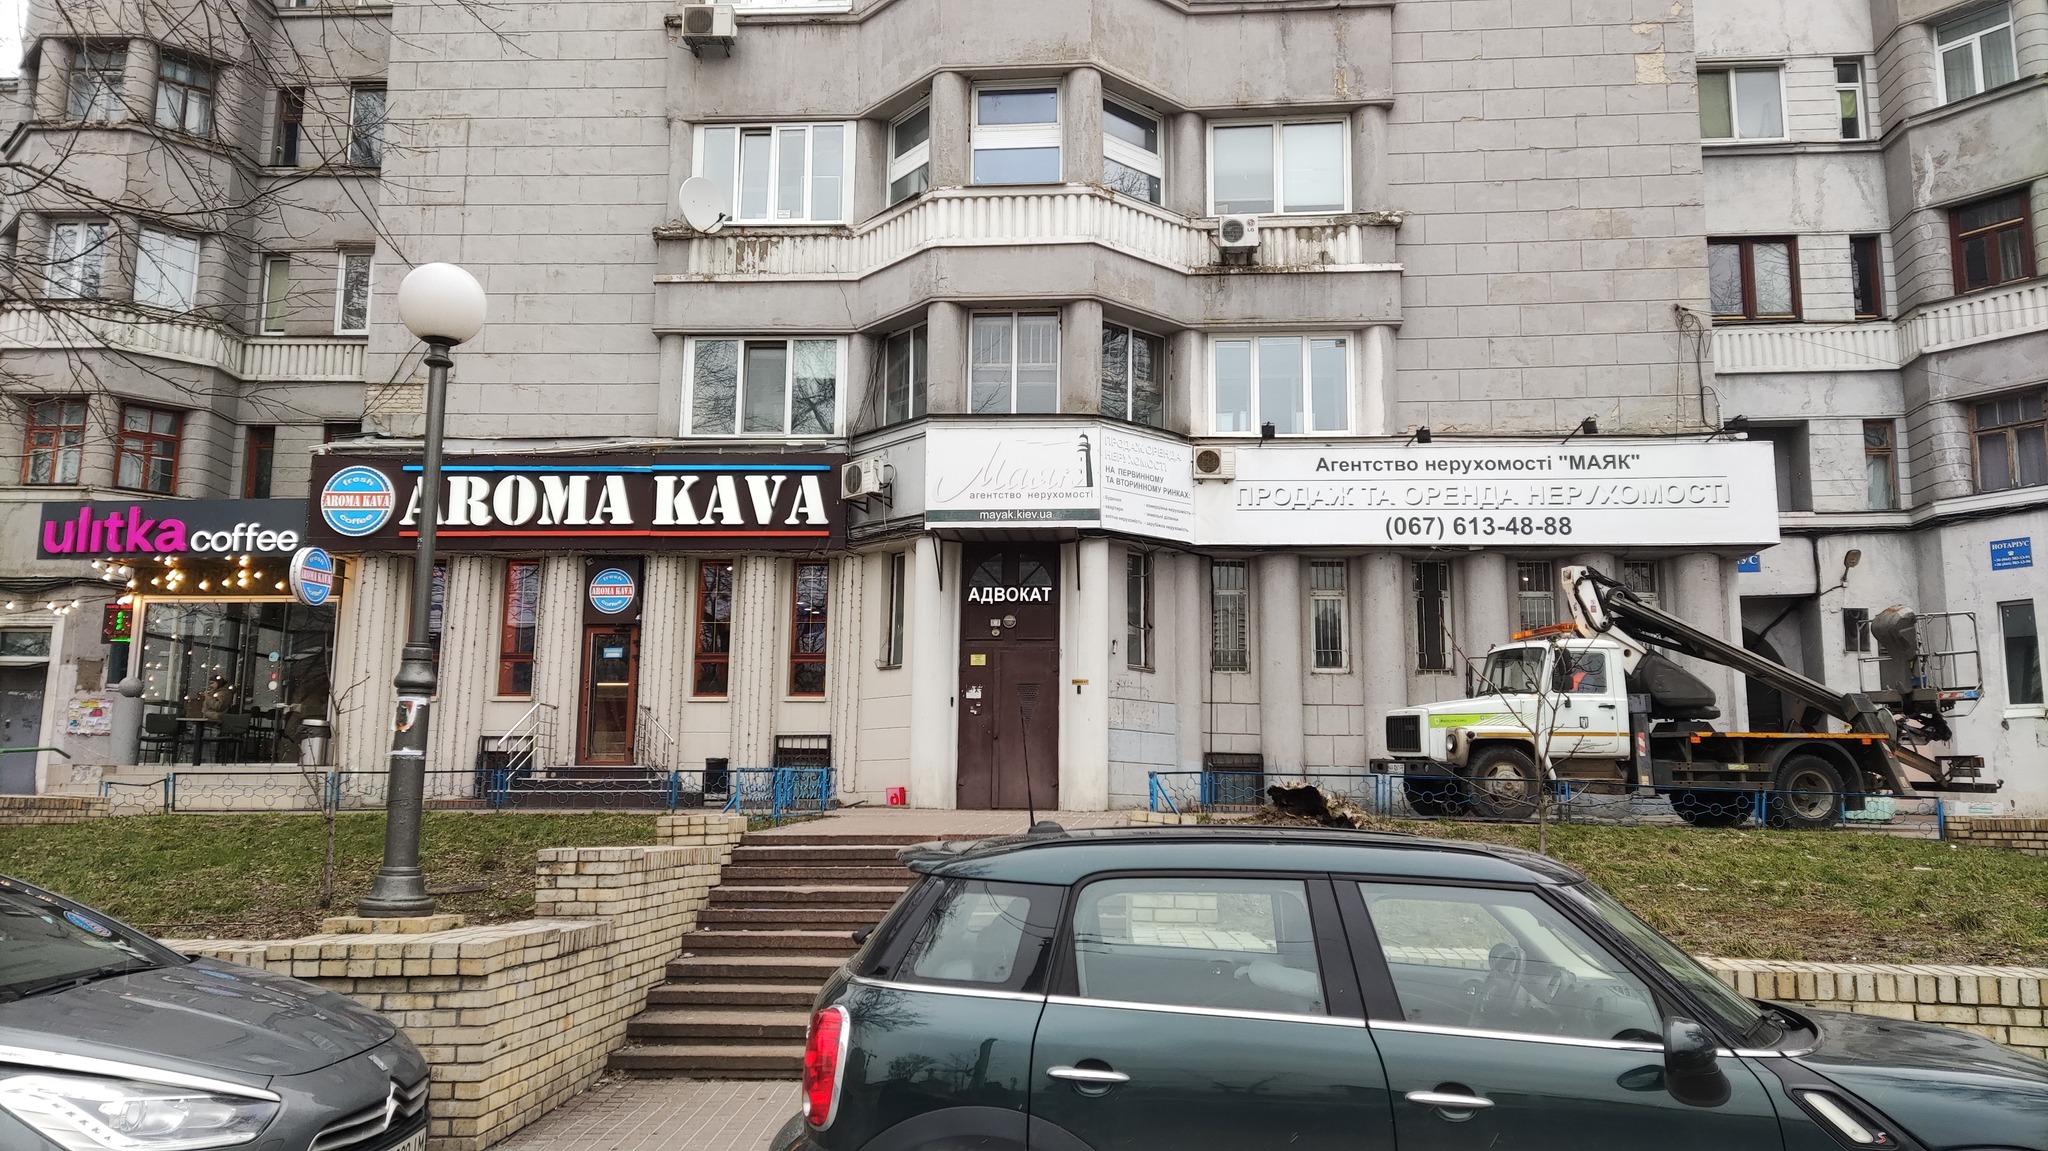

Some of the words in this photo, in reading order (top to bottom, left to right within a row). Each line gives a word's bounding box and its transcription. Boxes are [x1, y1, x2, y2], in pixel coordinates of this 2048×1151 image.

[1315, 457, 1419, 472] Агентство
[1425, 456, 1552, 474] нерухомості
[1558, 454, 1640, 470] "МАЯК"
[342, 477, 373, 486] fresh
[1105, 465, 1115, 474] НА
[1118, 468, 1164, 483] ПЕРВИННОМУ
[969, 491, 1022, 499] агентство
[1028, 490, 1093, 501] нерухомості
[1105, 476, 1114, 484] ТА
[1116, 478, 1161, 493] ВТОРИННОМУ
[1163, 487, 1191, 499] РИНКАХ:
[324, 494, 360, 507] AROMA
[362, 494, 389, 507] KAVA
[651, 475, 830, 525] KAVA
[1236, 486, 1354, 510] ПРОДАЖ
[1361, 486, 1396, 505] ТА
[1405, 485, 1519, 510] ОРЕНДА
[1528, 483, 1731, 506] НЕРУХОМОСТІ
[340, 514, 373, 524] coffee
[980, 510, 1052, 521] mayak.kiev.ua
[1385, 516, 1445, 540] (067)
[1453, 516, 1573, 536] 613-48-88
[191, 523, 299, 551] coffee
[1992, 540, 2030, 550] НОТАРІУС
[592, 587, 614, 595] AROMA
[615, 587, 632, 595] KAVA
[968, 587, 1052, 604] АДВОКАТ
